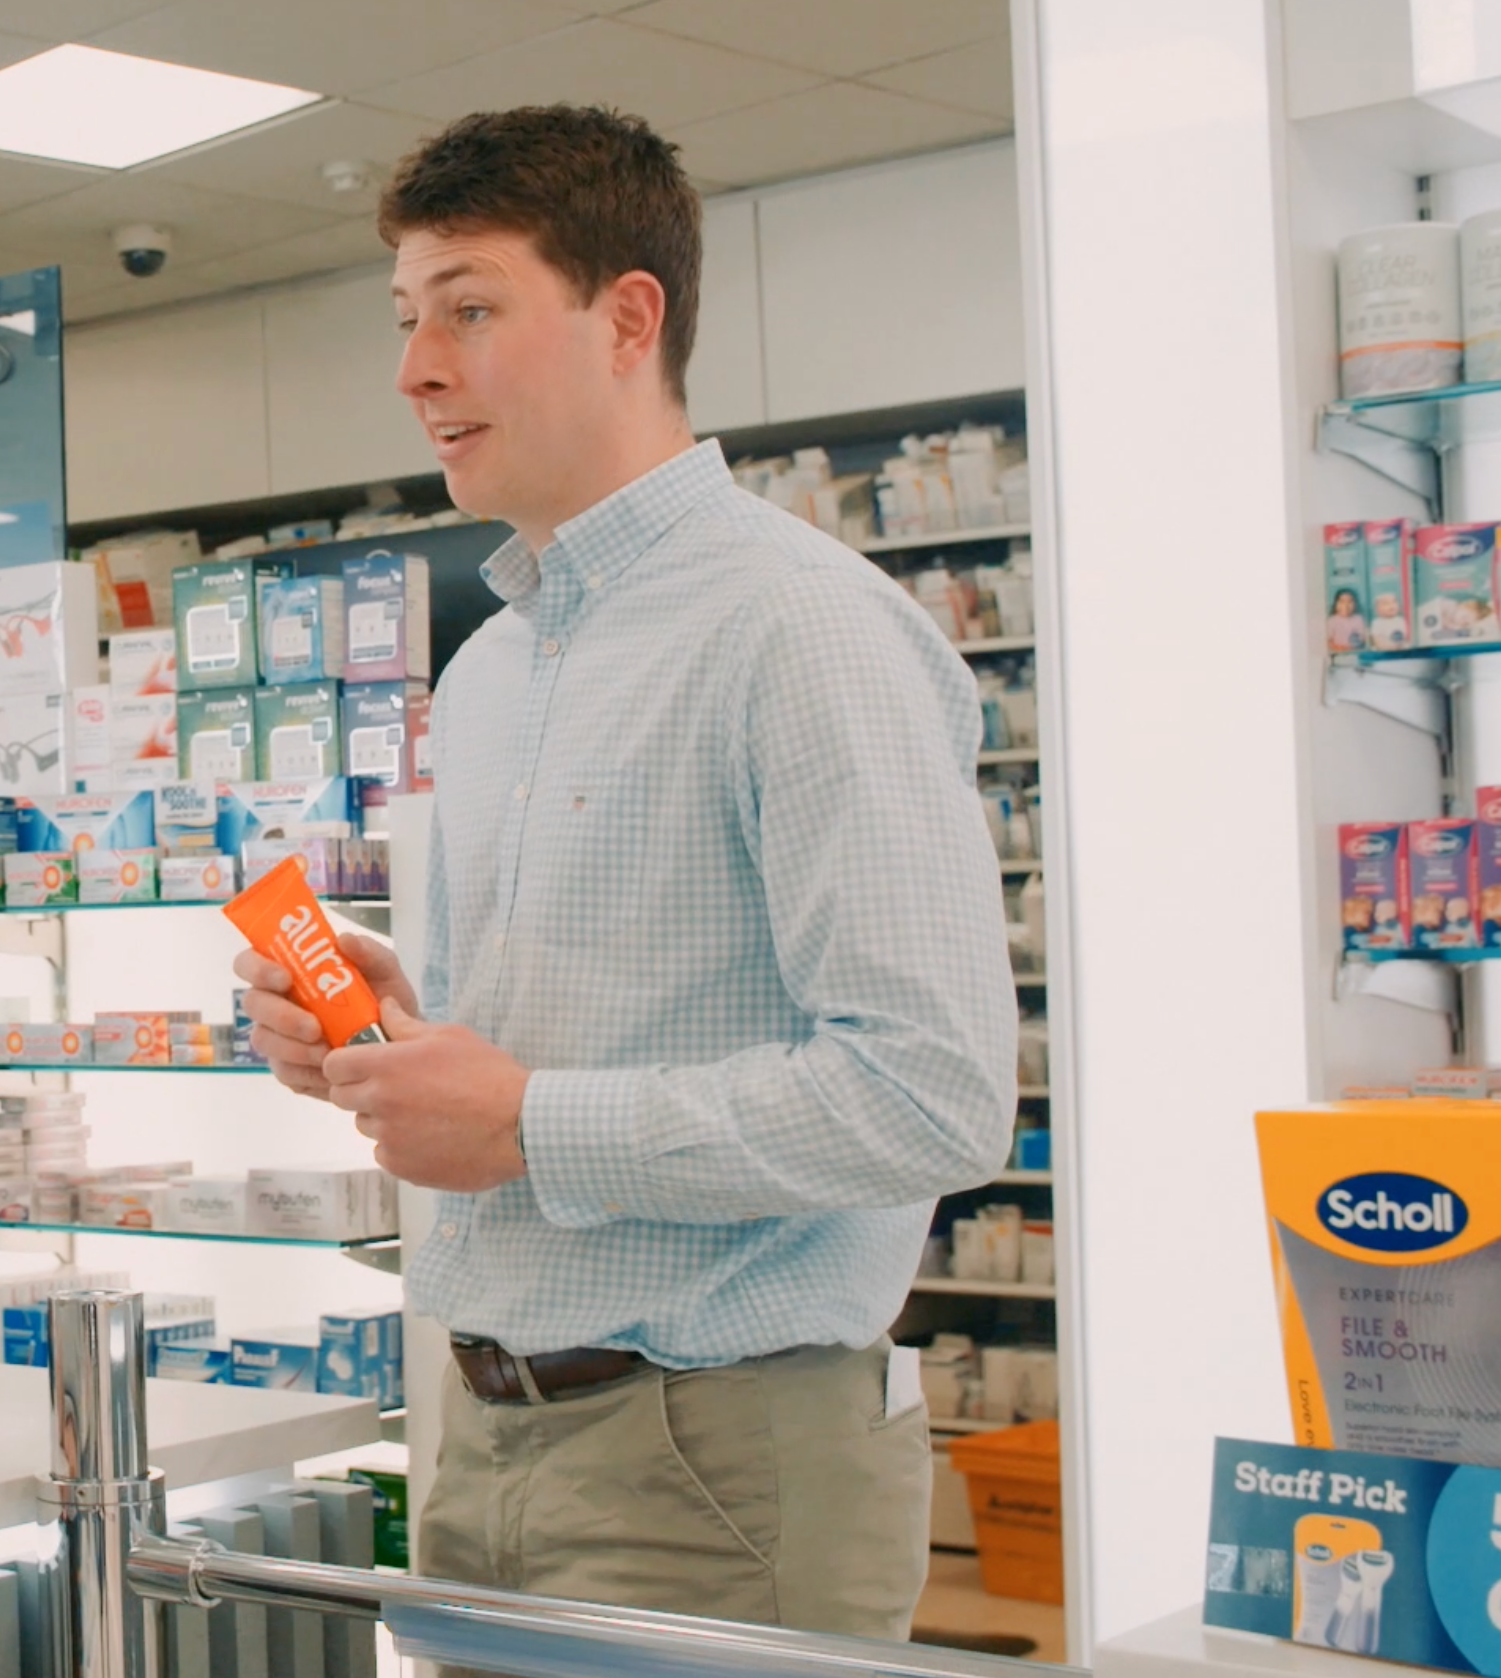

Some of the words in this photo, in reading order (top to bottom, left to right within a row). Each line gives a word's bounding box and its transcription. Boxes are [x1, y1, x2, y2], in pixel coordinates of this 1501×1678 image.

[252, 784, 308, 798] NUROFEN
[55, 797, 112, 811] NUROFEN
[279, 905, 354, 1001] aura
[257, 1191, 321, 1212] mybufen
[1326, 1188, 1454, 1233] Scholl
[1338, 1287, 1455, 1308] EXPERTCARE
[1341, 1316, 1384, 1337] FILE
[1393, 1319, 1409, 1338] &
[1341, 1338, 1448, 1364] SMOOTH
[1345, 1398, 1411, 1416] Electronic
[1234, 1461, 1324, 1502] Staff
[1328, 1472, 1407, 1514] Pick
